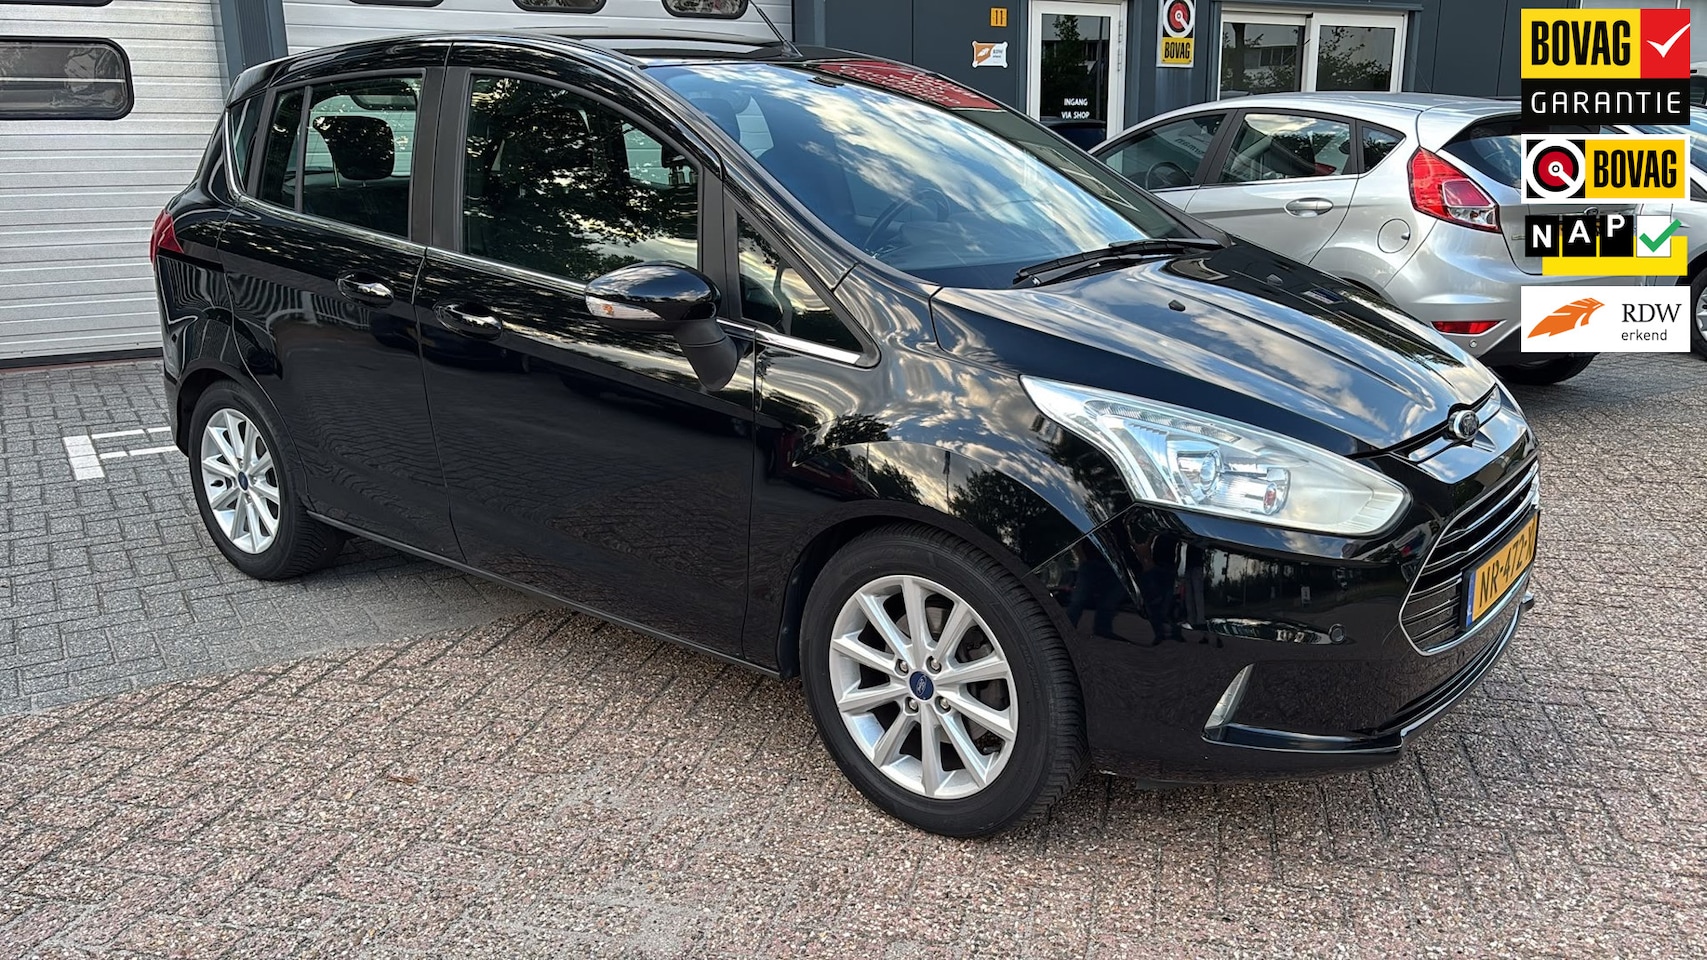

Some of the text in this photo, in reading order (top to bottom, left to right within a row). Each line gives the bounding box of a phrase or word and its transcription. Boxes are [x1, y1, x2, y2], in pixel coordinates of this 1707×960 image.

[995, 10, 1003, 25] 11
[1164, 41, 1191, 59] BOVAG
[1063, 98, 1088, 106] INGANG
[1061, 111, 1090, 119] VIA SHOP
